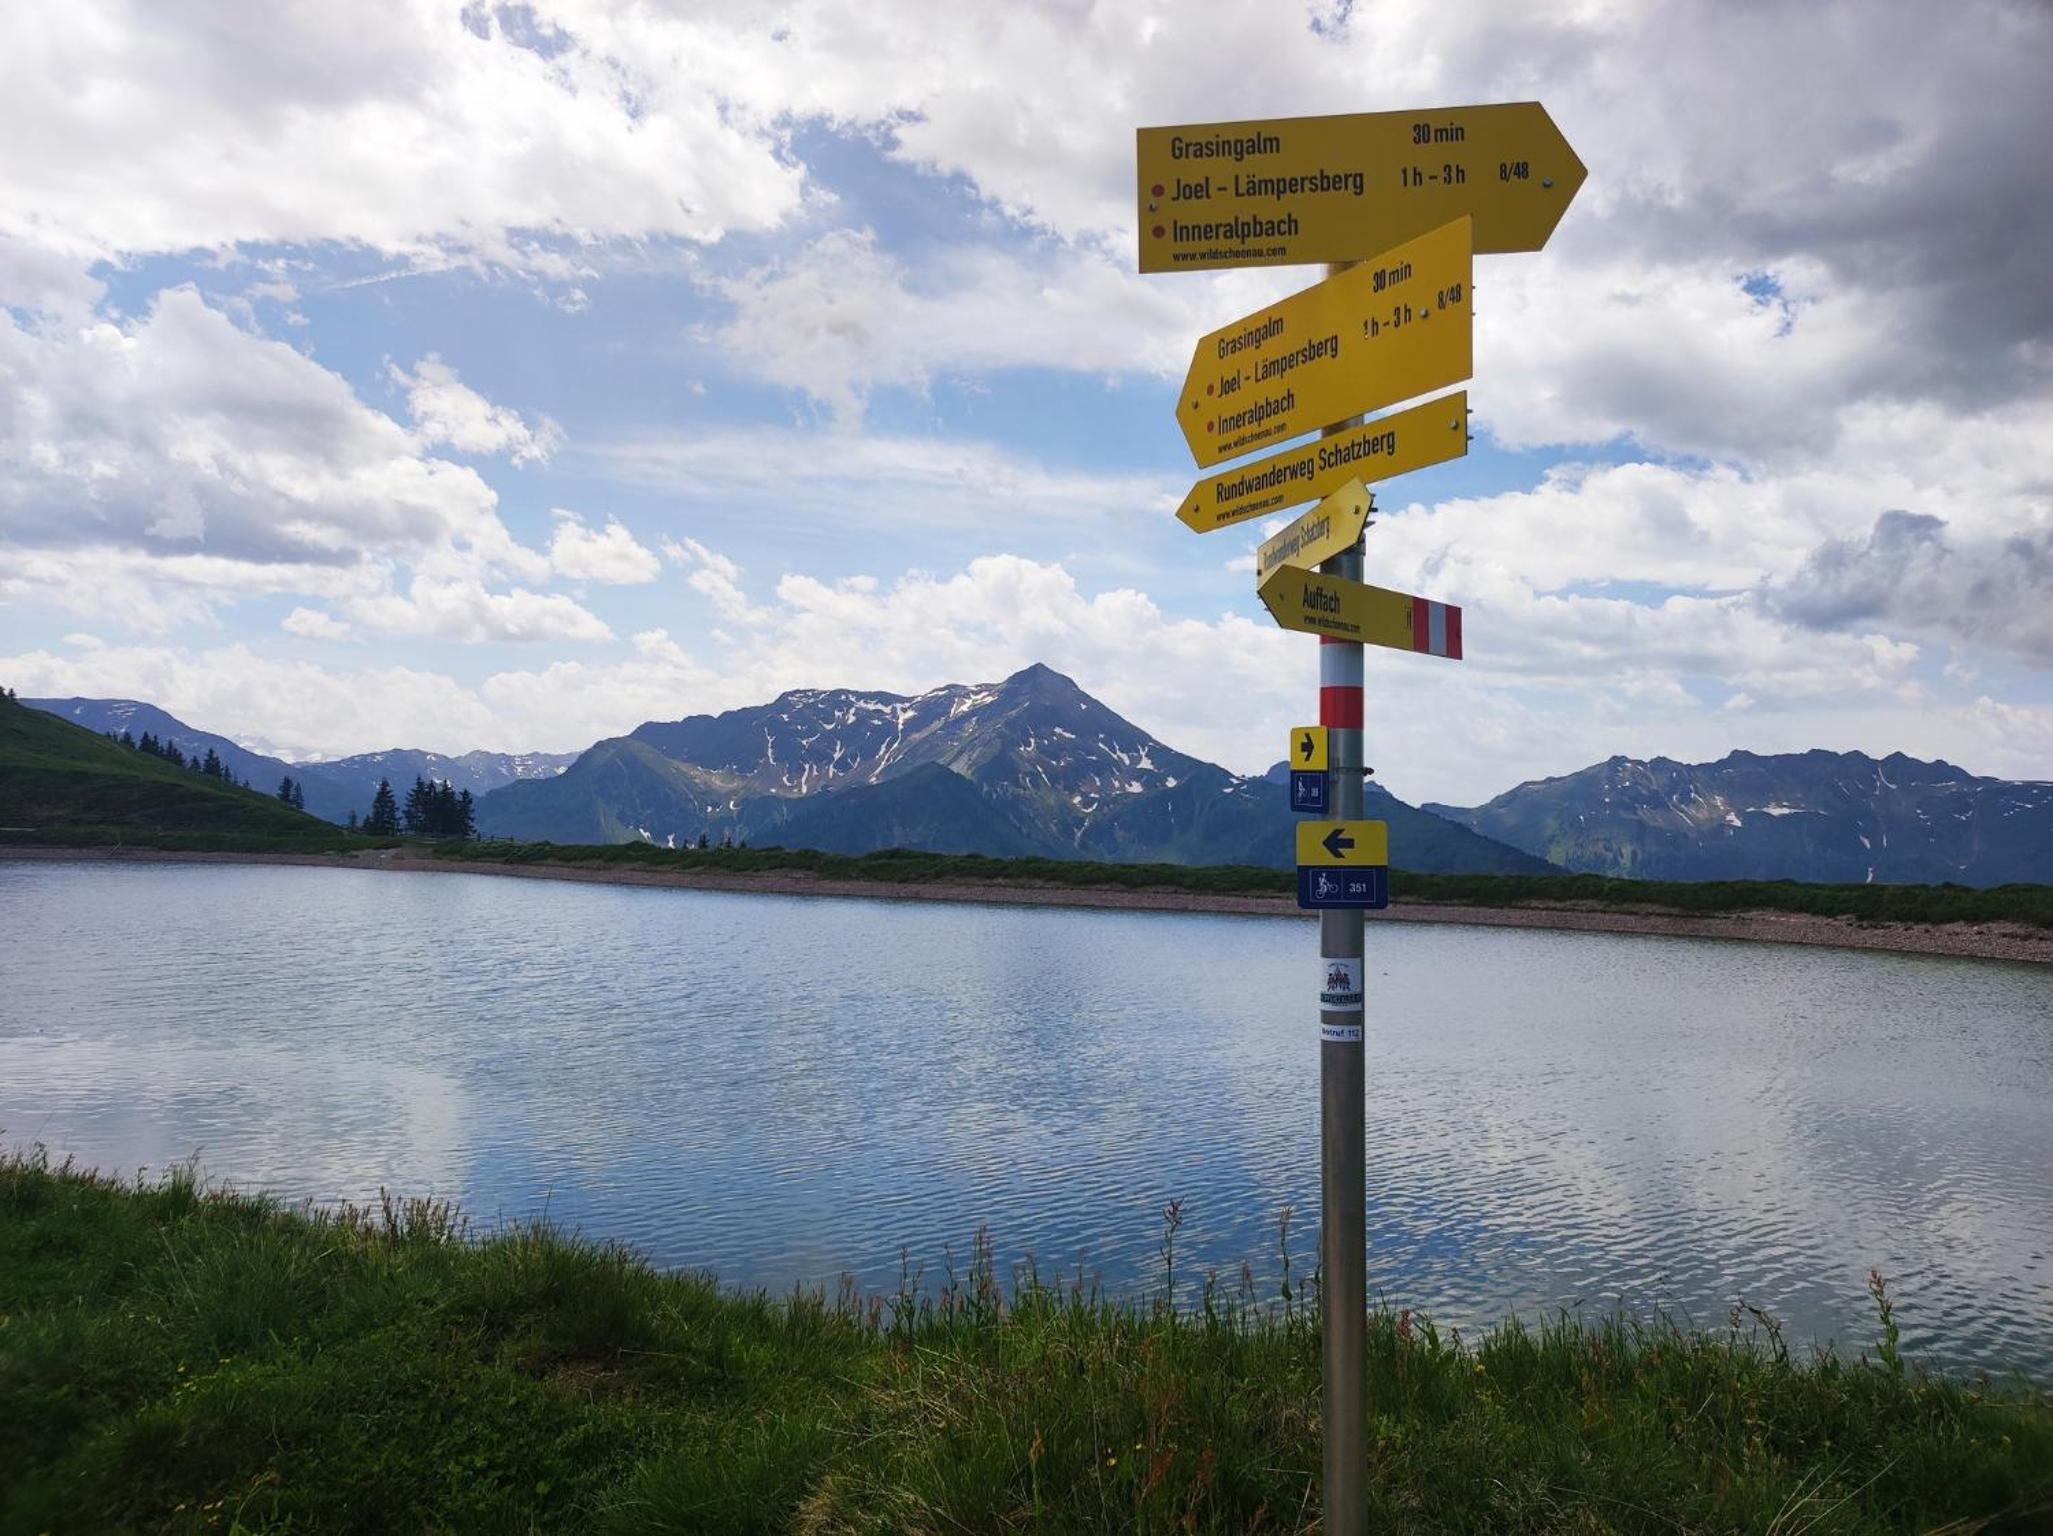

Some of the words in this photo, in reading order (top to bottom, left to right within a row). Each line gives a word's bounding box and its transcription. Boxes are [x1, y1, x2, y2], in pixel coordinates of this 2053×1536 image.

[1171, 132, 1280, 162] Grasingalm
[1413, 123, 1431, 145] 30
[1435, 122, 1465, 143] min
[1172, 176, 1211, 201] Joel
[1235, 169, 1364, 201] Lämpersberg
[1402, 167, 1408, 187] 1
[1413, 167, 1423, 187] h
[1443, 164, 1452, 185] 3
[1456, 164, 1465, 184] h
[1499, 161, 1529, 183] 8/48
[1173, 213, 1299, 244] Inneralpbach
[1173, 245, 1286, 262] www.wildschoenau.com
[1373, 269, 1386, 293] 30
[1388, 261, 1412, 287] min
[1437, 283, 1462, 310] 8/48
[1371, 317, 1379, 337] h
[1394, 306, 1401, 328] 3
[1404, 303, 1412, 324] h
[1218, 317, 1284, 359] Grasingalm
[1217, 368, 1241, 398] Joel
[1254, 334, 1339, 383] Lämpersberg
[1218, 388, 1295, 436] Inneralpbach
[1216, 459, 1314, 505] Rundwanderweg
[1318, 430, 1396, 471] Schatzberg
[1302, 583, 1341, 615] Auffach
[1349, 882, 1367, 893] 351
